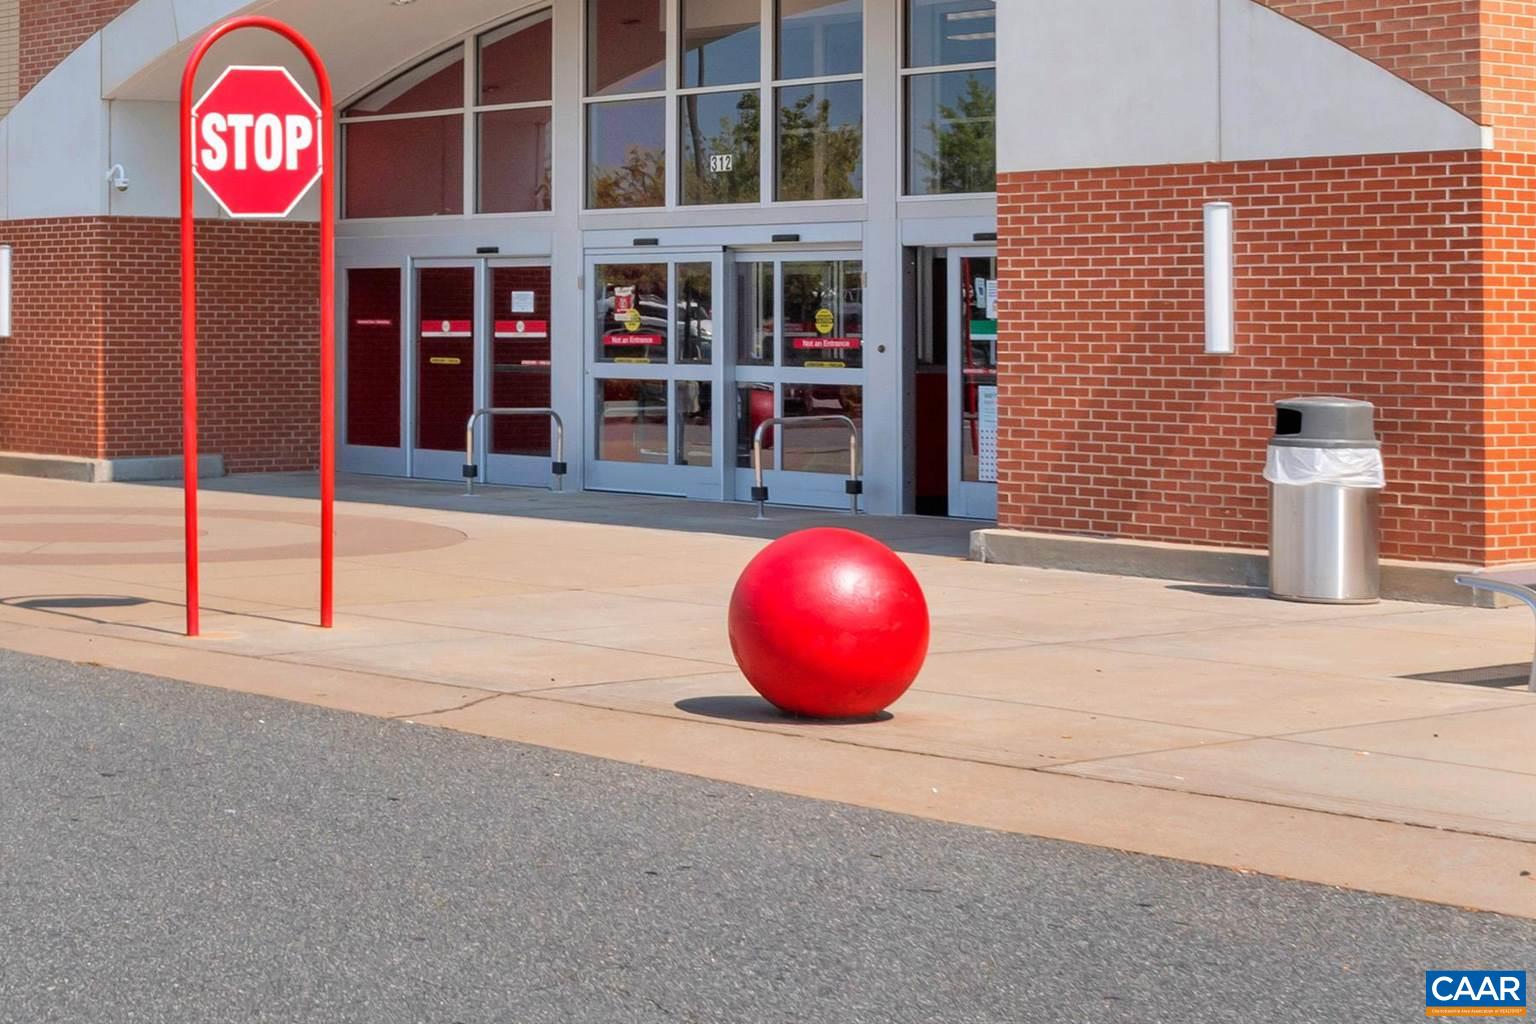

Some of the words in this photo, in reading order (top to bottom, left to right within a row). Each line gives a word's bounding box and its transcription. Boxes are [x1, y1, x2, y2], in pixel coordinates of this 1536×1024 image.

[201, 112, 313, 171] STOP
[711, 156, 731, 171] 312
[802, 339, 814, 347] Not
[823, 339, 850, 347] Entrance
